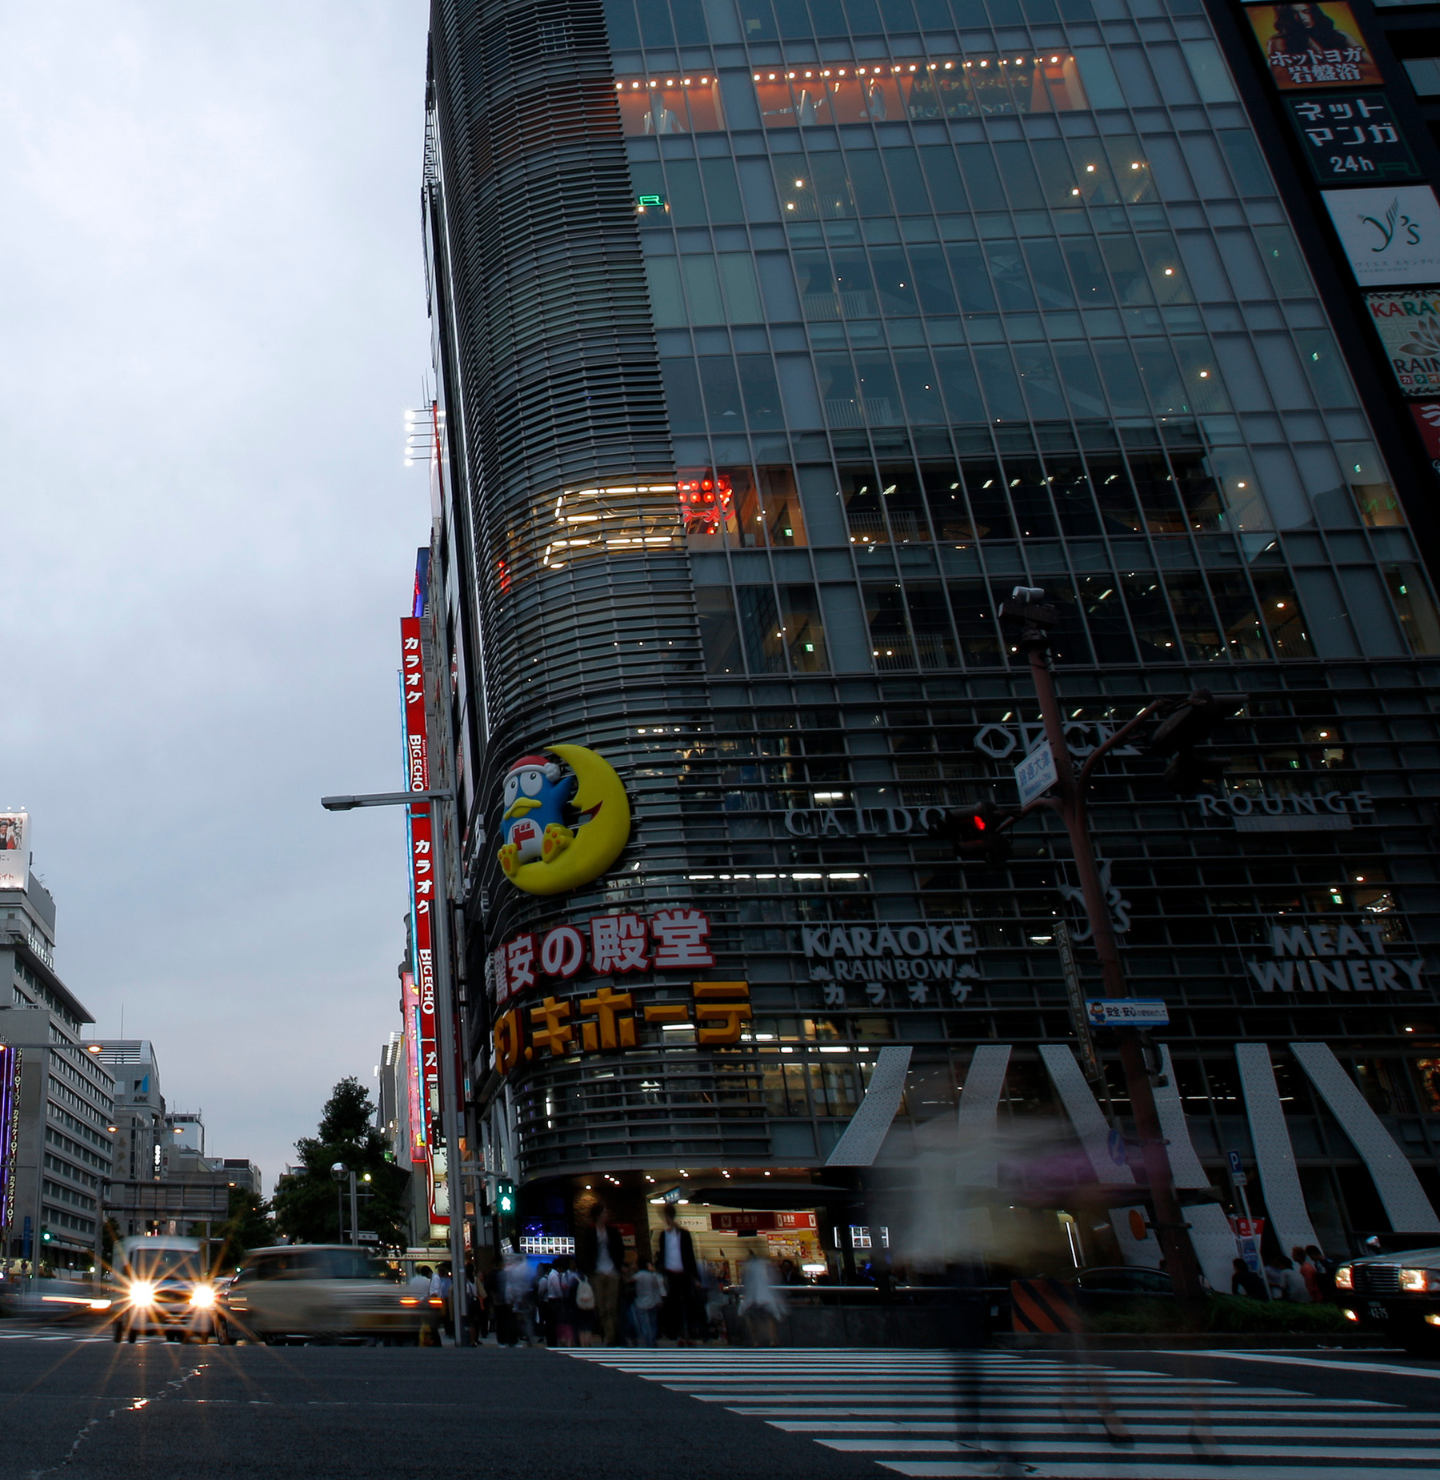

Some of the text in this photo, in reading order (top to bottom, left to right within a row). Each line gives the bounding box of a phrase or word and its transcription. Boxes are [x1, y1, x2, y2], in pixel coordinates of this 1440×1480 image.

[1270, 47, 1363, 68] ホットヨガ
[1288, 63, 1362, 84] 岩盤浴
[1295, 99, 1384, 121] ネット
[1305, 122, 1400, 147] マンガ
[1330, 155, 1376, 173] 24h
[404, 636, 423, 704] カラオケ
[409, 734, 424, 792] BIG ECHO
[1196, 790, 1376, 817] ROUNGE
[415, 839, 433, 915] カラオケ
[802, 925, 977, 958] KARAOKE
[1270, 925, 1386, 956] MEAT
[834, 958, 954, 980] RAINBOW
[1246, 959, 1426, 992] WINERY
[823, 980, 973, 1005] カラオケ
[1229, 1153, 1239, 1166] P
